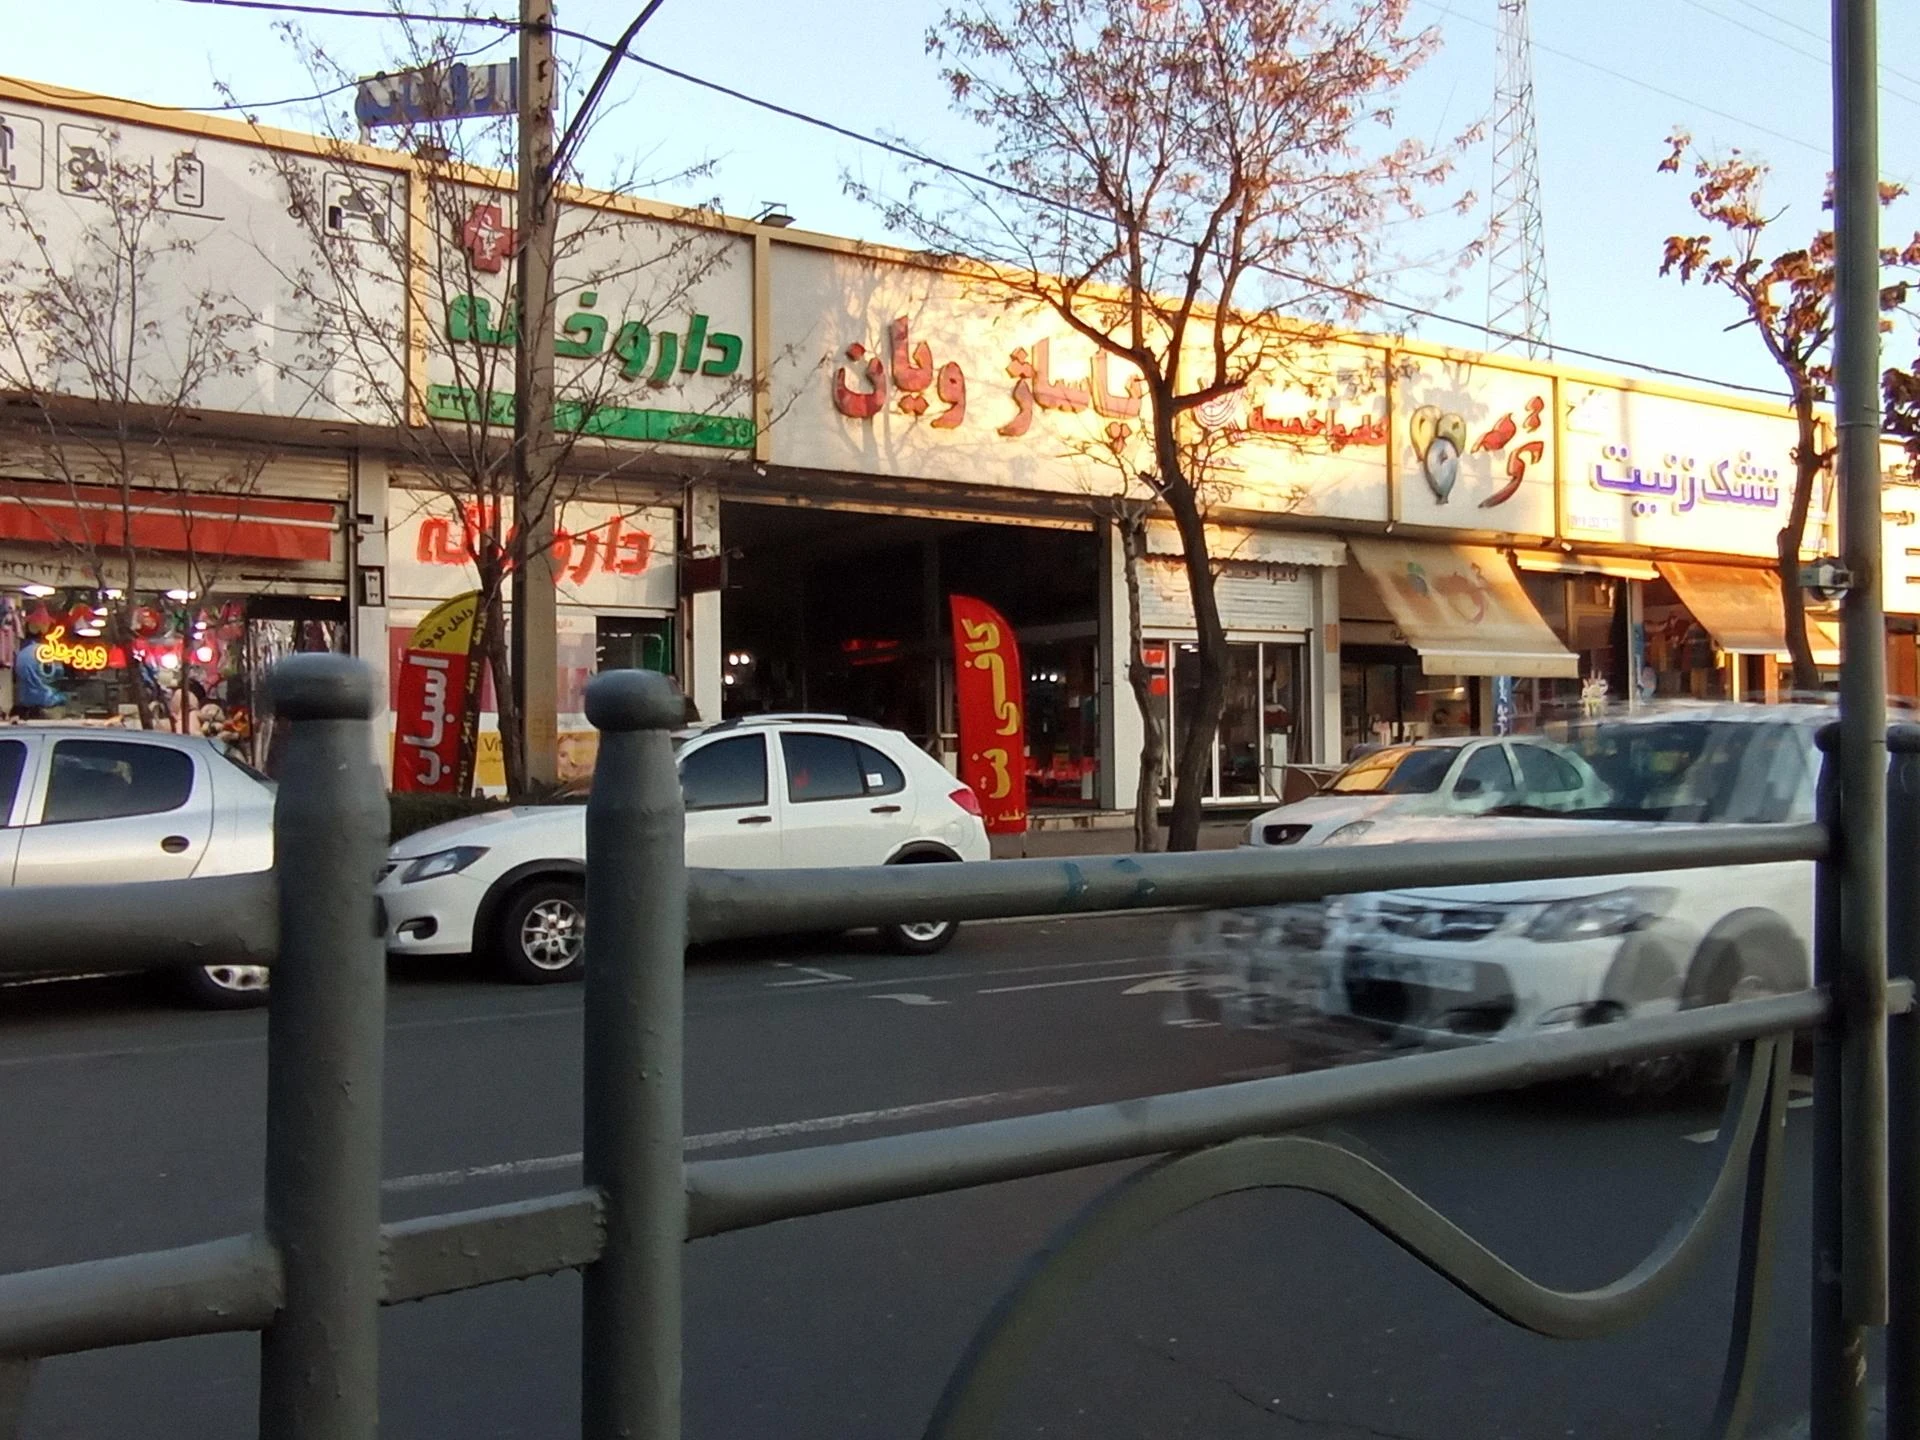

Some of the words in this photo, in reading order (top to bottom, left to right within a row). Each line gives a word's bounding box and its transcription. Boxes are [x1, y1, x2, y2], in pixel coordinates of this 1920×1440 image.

[447, 291, 744, 390] داروخنه
[996, 337, 1143, 454] پاساژ
[1590, 444, 1697, 518] زنیت
[1702, 450, 1779, 509] تشک
[36, 626, 108, 670] وروجک
[448, 608, 474, 632] داخل
[961, 618, 1021, 736] کافی
[402, 655, 455, 786] اسباب
[971, 747, 1011, 799] نت
